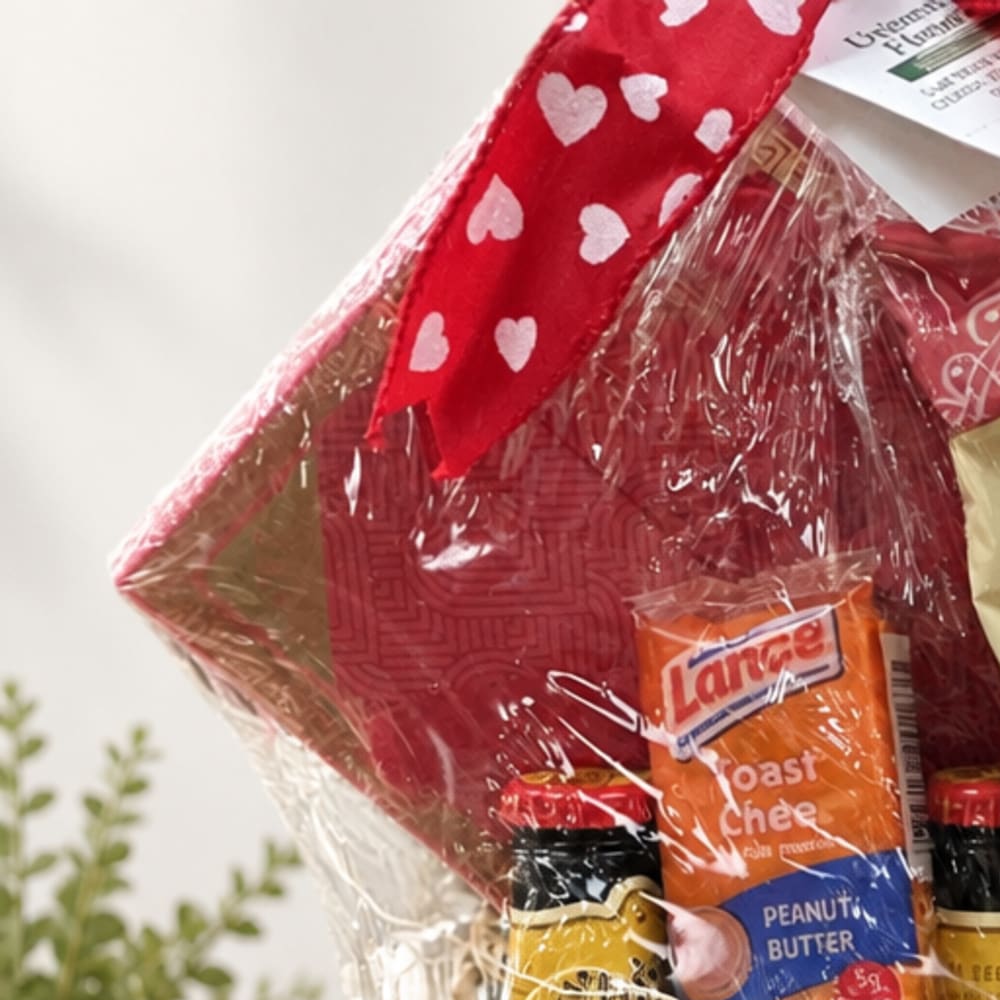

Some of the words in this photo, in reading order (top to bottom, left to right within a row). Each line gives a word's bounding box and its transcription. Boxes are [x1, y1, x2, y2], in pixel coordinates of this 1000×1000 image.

[670, 618, 827, 726] Lance
[762, 896, 854, 928] PEANUT
[766, 929, 857, 961] BUTTER
